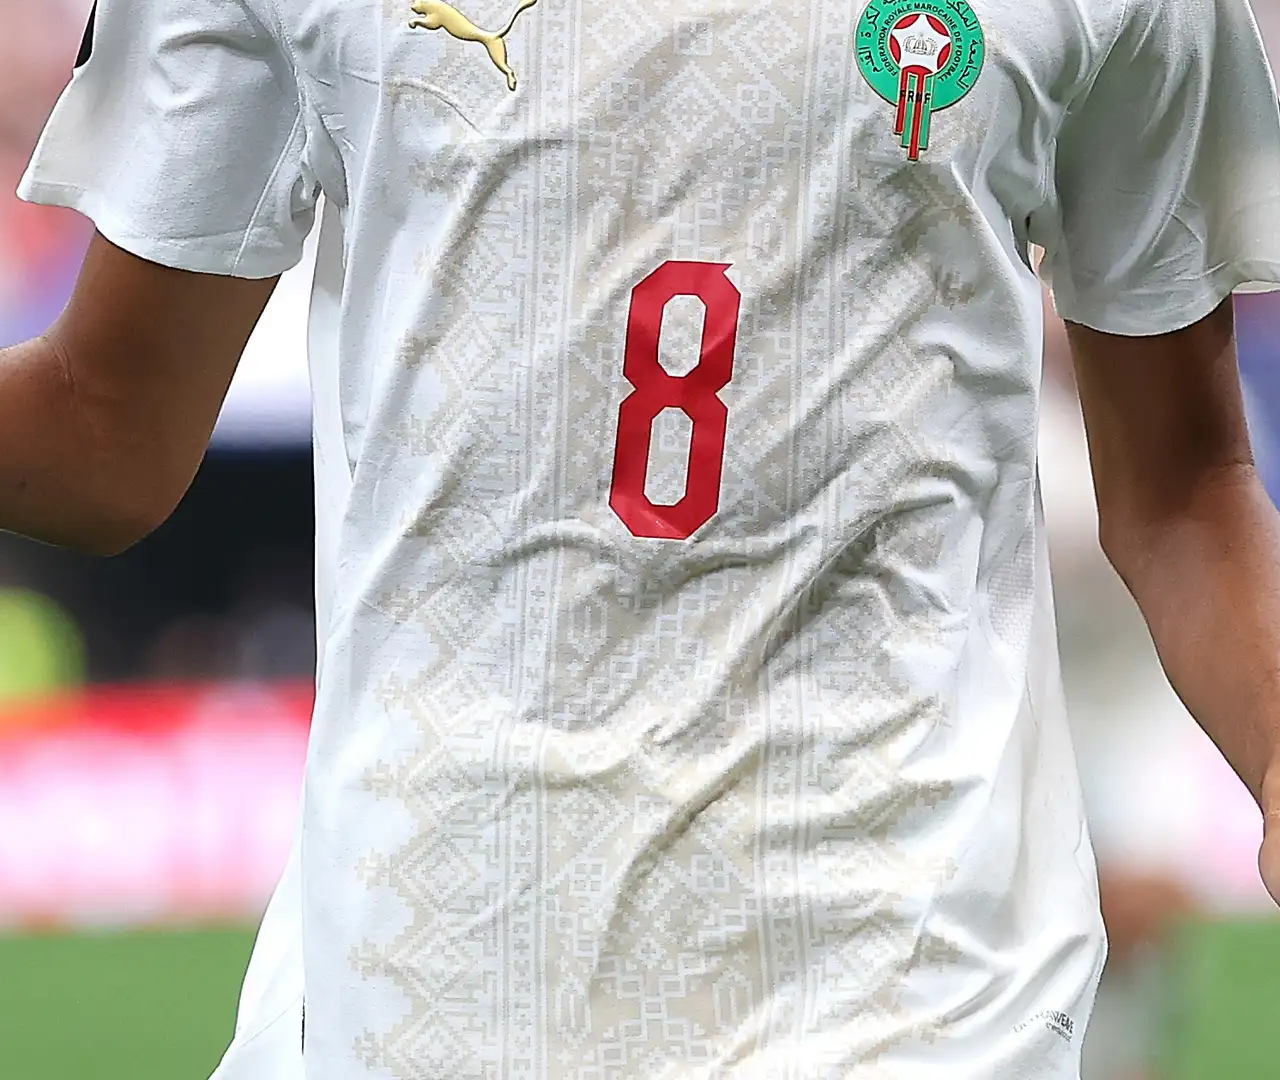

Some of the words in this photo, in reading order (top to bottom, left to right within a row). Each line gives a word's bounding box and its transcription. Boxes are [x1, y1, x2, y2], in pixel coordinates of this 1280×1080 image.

[860, 5, 880, 38] لكرة
[884, 3, 912, 26] ROYALE
[913, 2, 958, 30] MAROCAINE
[878, 27, 897, 76] FEDERATION
[953, 31, 962, 43] DE
[937, 44, 962, 82] FOOTBALL
[956, 39, 982, 90] الجامعة
[608, 260, 741, 540] 8
